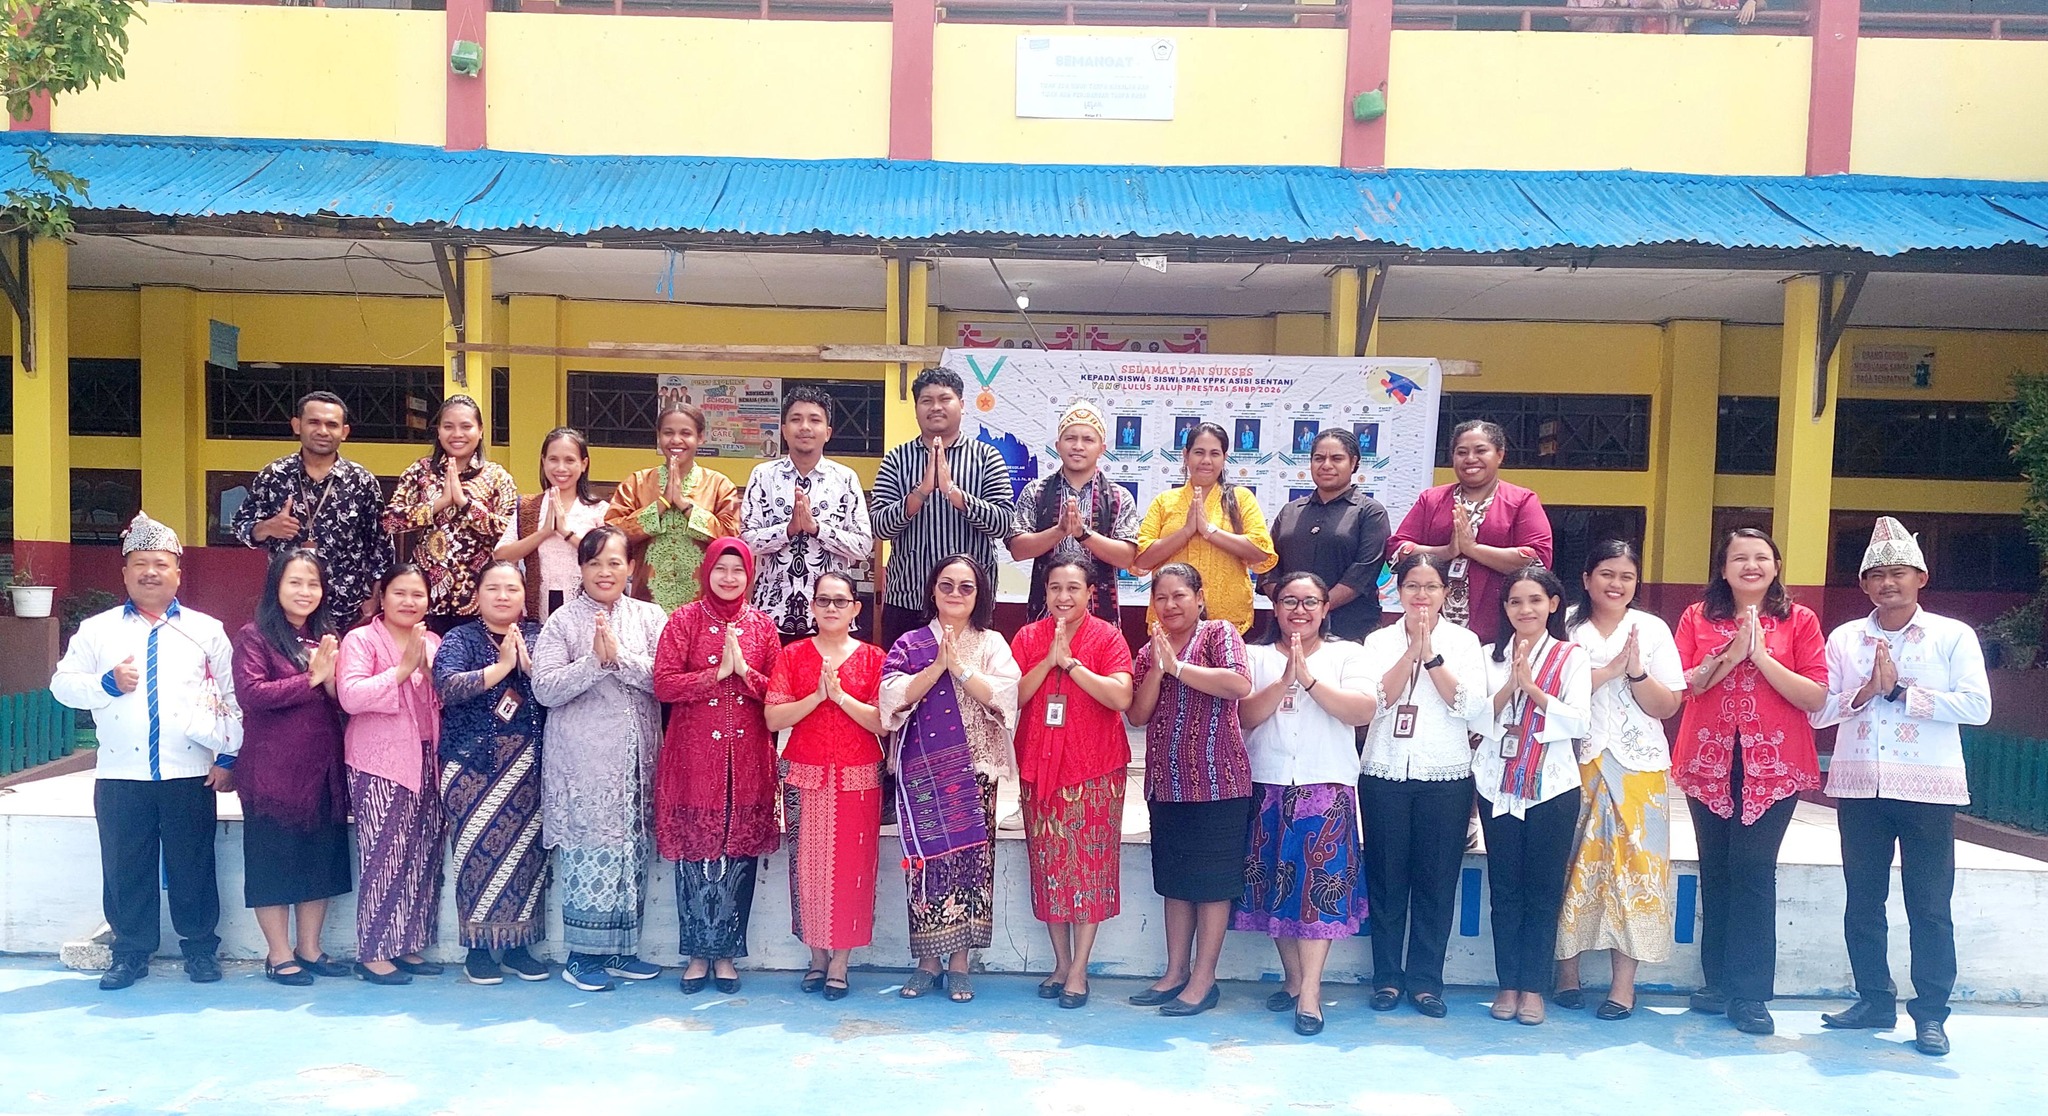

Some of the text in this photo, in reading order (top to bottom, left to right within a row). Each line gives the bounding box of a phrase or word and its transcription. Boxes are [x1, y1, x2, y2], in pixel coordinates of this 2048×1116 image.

[1055, 55, 1134, 68] SEMANGAT
[1121, 364, 1254, 377] SELAMAT DAN SUKSES
[1080, 374, 1116, 382] KEPADA
[1181, 376, 1200, 384] SMA
[1228, 377, 1252, 385] ASISI
[1254, 378, 1293, 386] SENTANI
[1091, 381, 1121, 391] YANG
[1258, 386, 1282, 394] 2026
[712, 430, 733, 438] CARE
